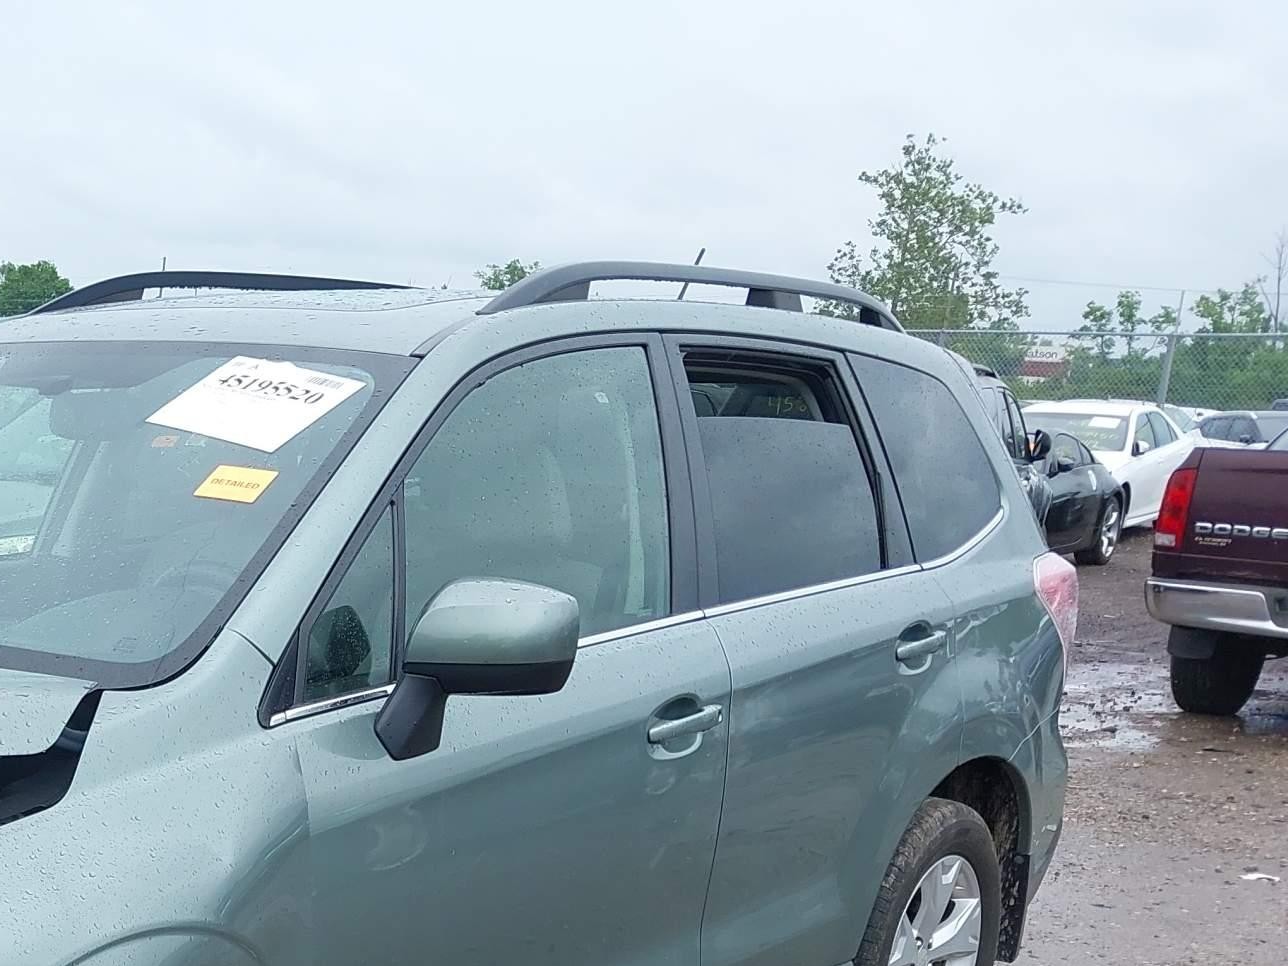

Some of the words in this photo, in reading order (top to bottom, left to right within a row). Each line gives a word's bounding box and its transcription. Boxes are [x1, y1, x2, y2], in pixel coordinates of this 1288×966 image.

[218, 374, 325, 405] 45195520
[210, 476, 261, 490] DETAILED
[1194, 521, 1288, 540] DODGE
